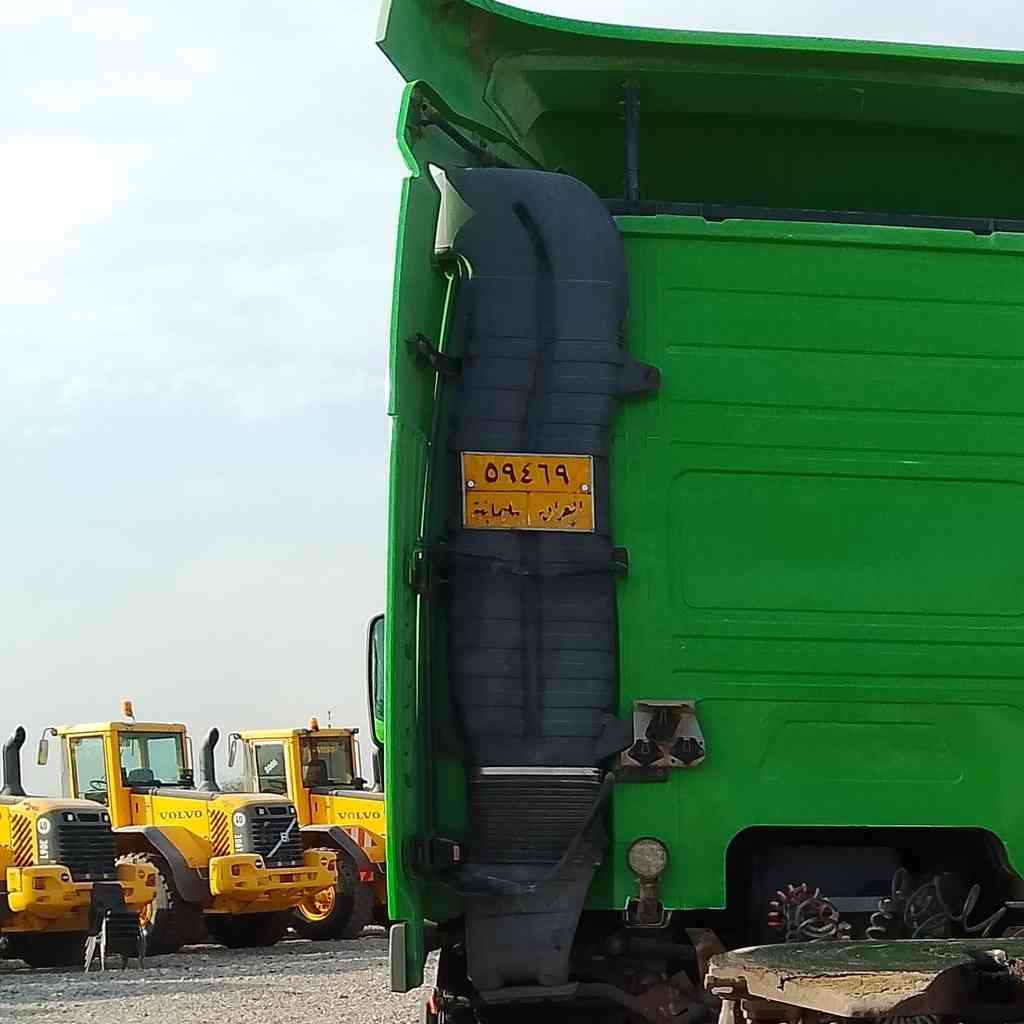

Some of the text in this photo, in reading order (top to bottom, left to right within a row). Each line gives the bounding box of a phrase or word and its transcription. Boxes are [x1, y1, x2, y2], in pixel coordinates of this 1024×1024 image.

[484, 462, 570, 485] ٥٩٤٦٩
[159, 809, 203, 821] VOLVO
[336, 811, 382, 821] VOLVO
